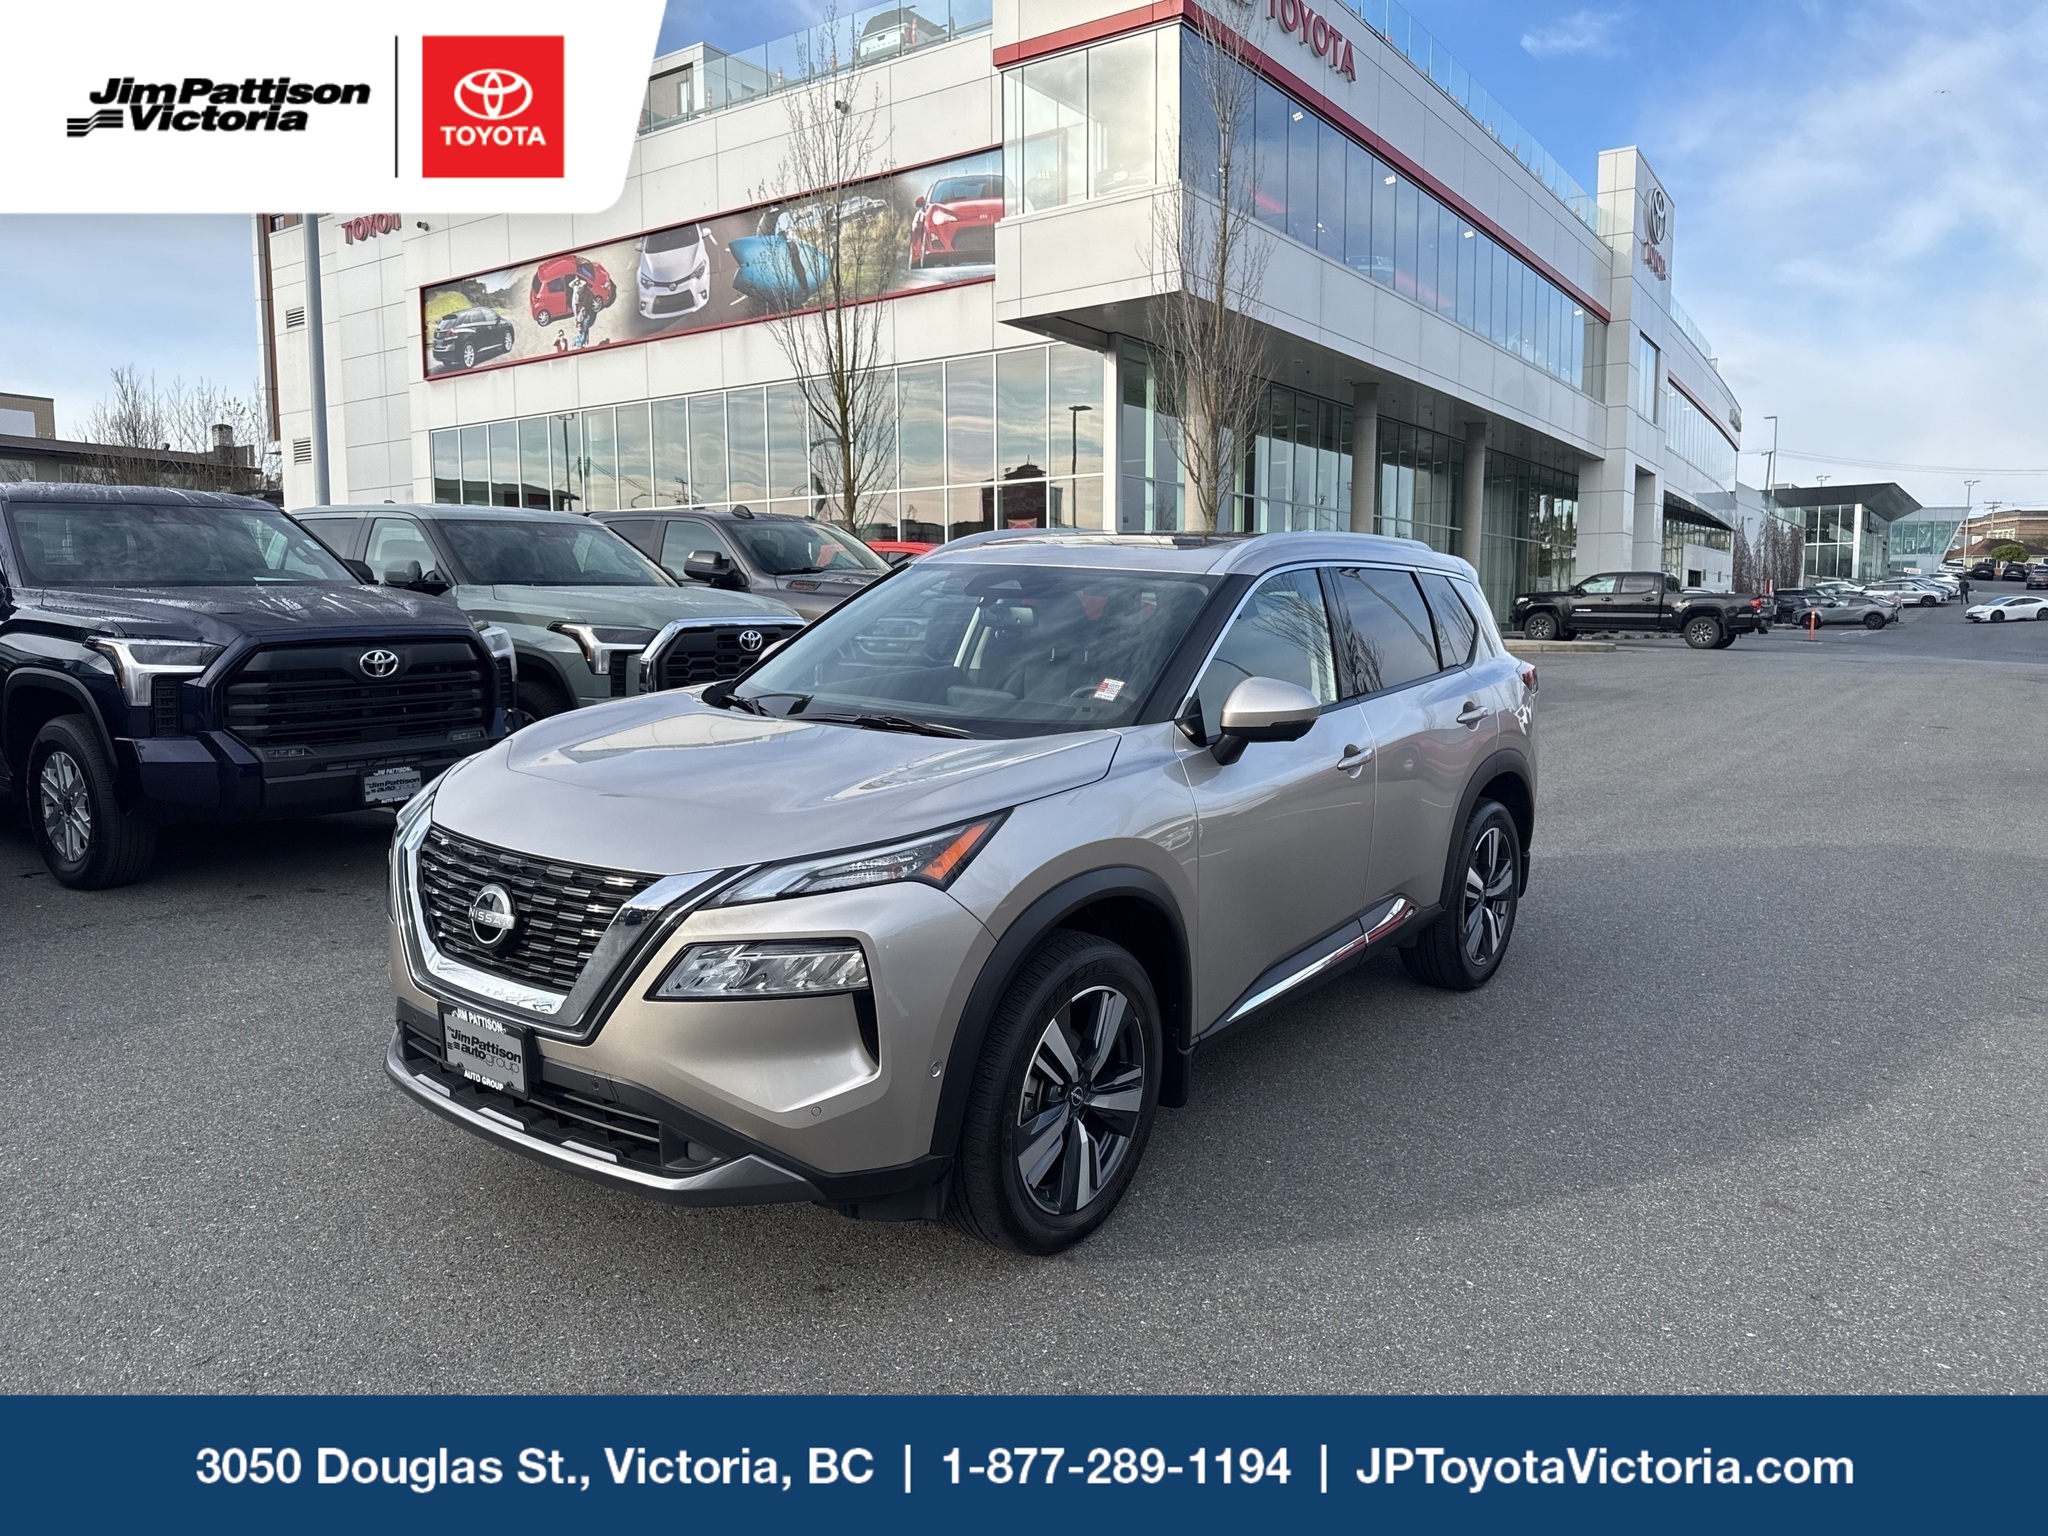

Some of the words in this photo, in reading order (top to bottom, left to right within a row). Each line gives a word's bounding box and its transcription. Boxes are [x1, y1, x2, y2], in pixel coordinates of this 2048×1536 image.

[468, 906, 513, 927] NISSAN
[456, 1007, 468, 1022] JIM
[468, 1011, 504, 1034] PATTISON
[463, 1069, 481, 1083] AUTO
[481, 1076, 504, 1091] GROUP
